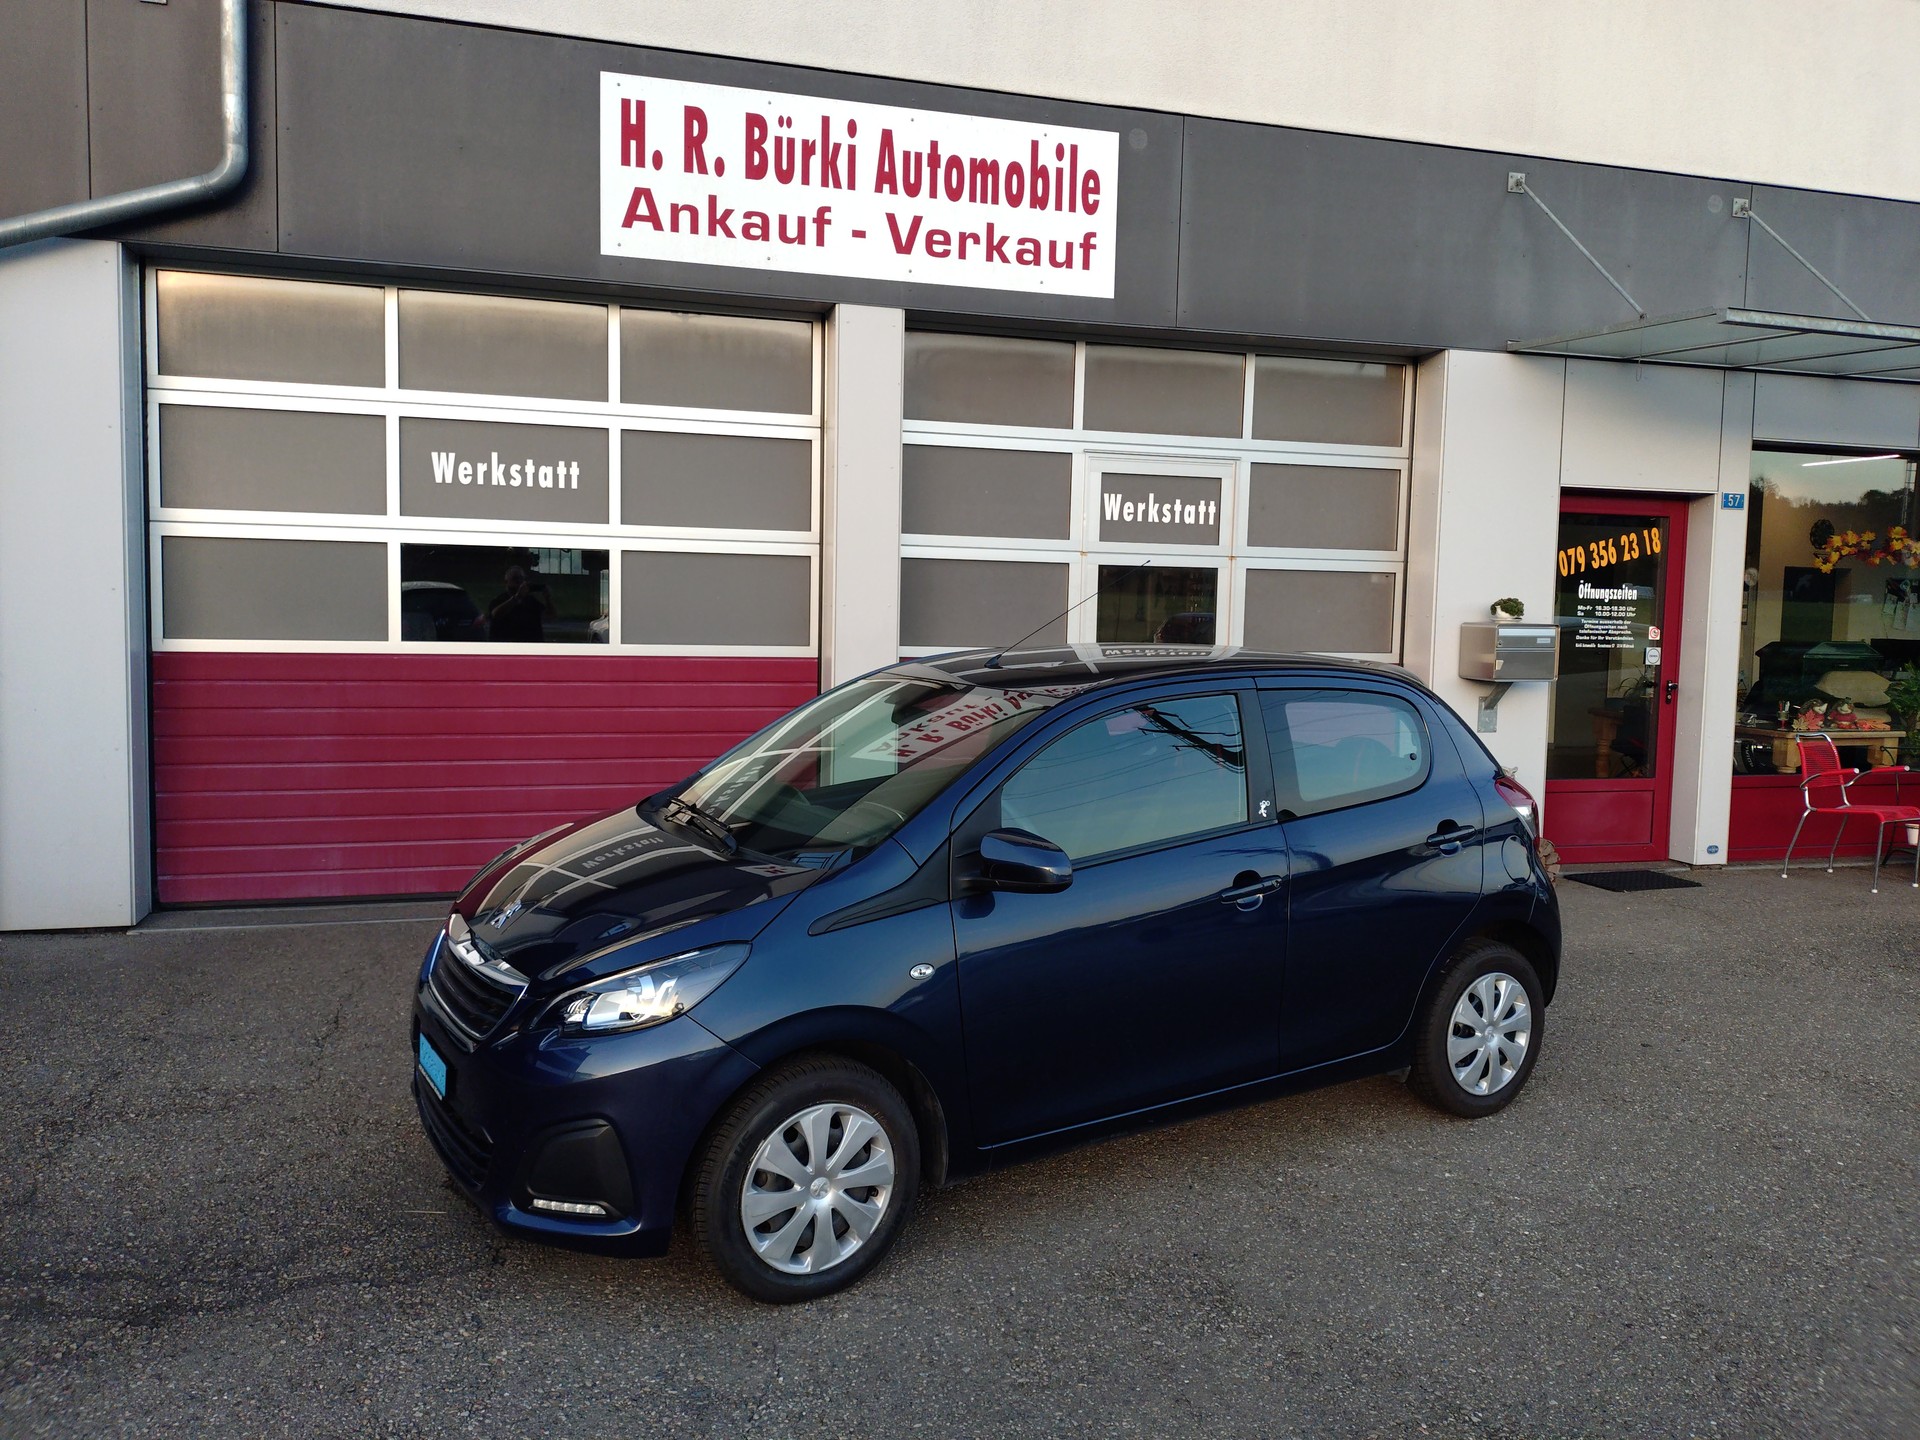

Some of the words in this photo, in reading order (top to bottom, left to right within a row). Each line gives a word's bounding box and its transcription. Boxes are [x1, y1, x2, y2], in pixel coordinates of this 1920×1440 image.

[620, 98, 663, 171] H.
[684, 105, 725, 178] R.
[745, 112, 858, 191] Bürki
[874, 128, 1101, 216] Automobile
[621, 187, 832, 247] Ankauf
[885, 212, 1097, 271] Verkauf
[431, 452, 580, 489] Werkstatt
[1104, 493, 1216, 525] Werkstatt
[1728, 494, 1740, 507] 57
[1559, 545, 1586, 577] 079
[1589, 537, 1617, 569] 356
[1620, 532, 1640, 562] 23
[1643, 527, 1661, 556] 18
[1578, 580, 1638, 603] Öffnungszeiten
